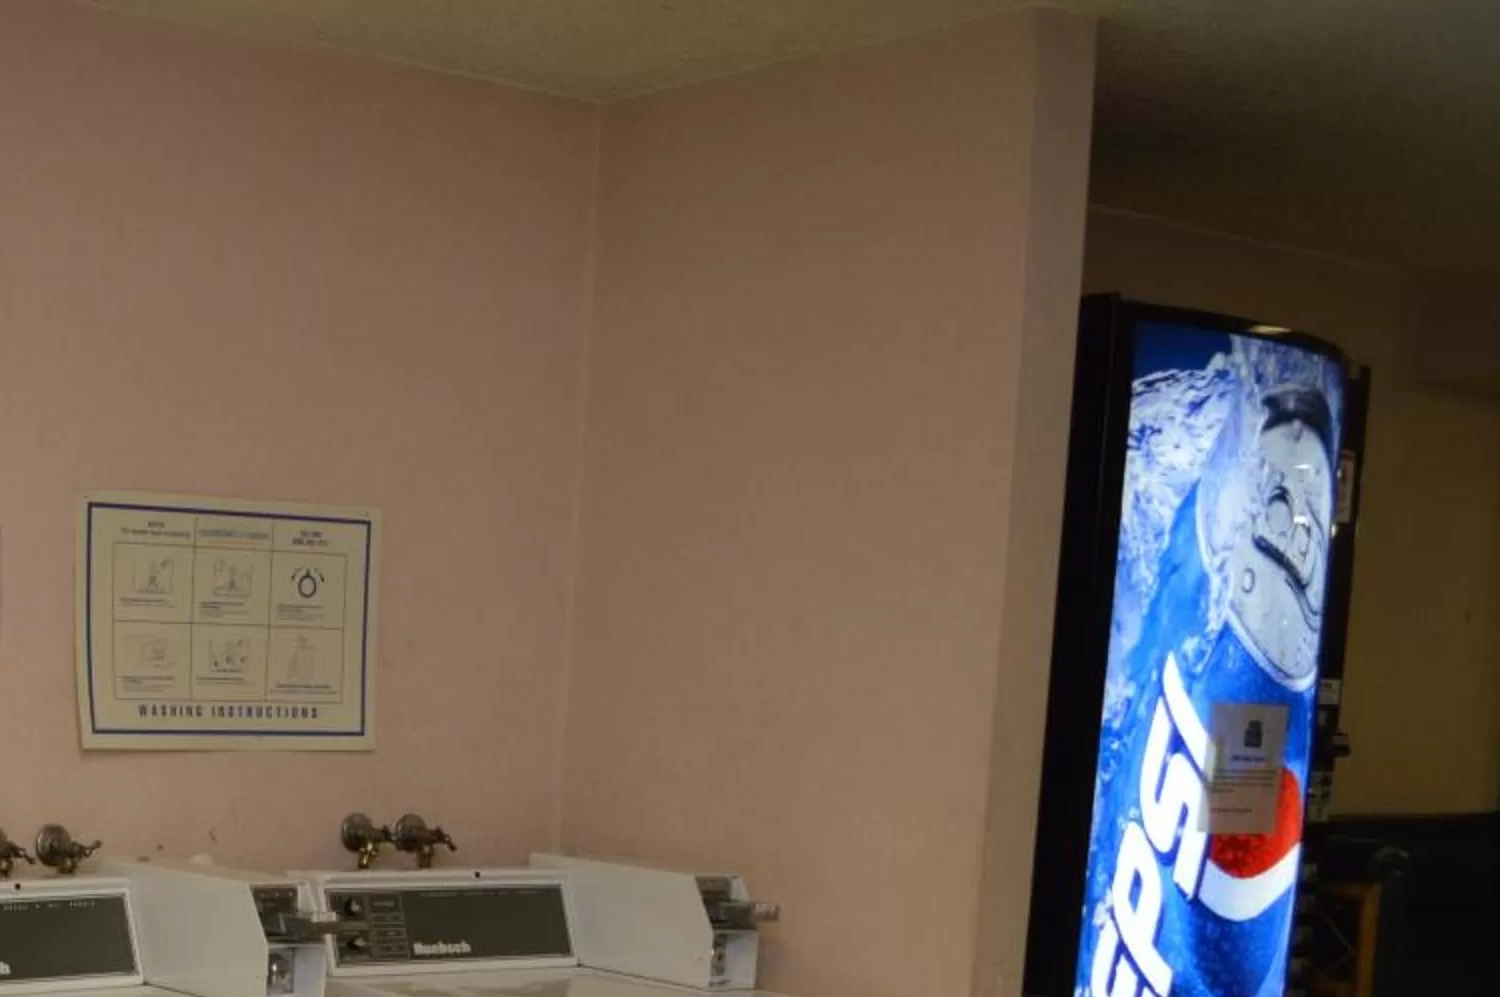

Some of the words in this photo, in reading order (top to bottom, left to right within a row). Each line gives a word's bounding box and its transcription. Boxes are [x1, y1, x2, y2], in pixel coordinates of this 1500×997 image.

[139, 703, 203, 718] WASHING
[211, 705, 318, 720] INSTRUCTIONS
[413, 940, 471, 956] Huebsch
